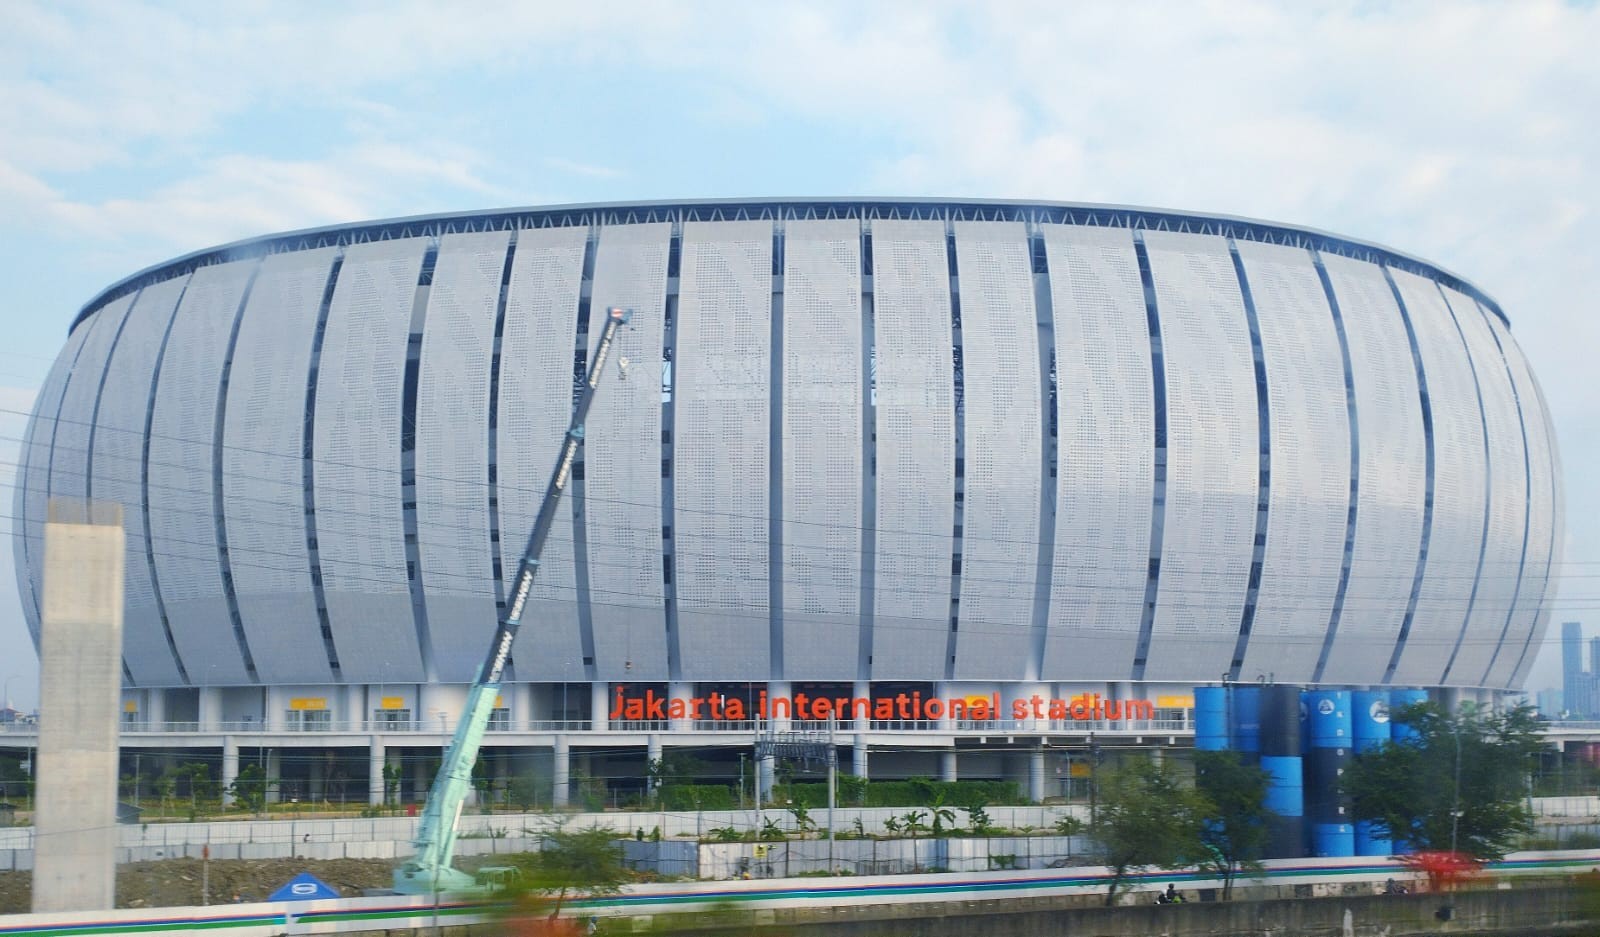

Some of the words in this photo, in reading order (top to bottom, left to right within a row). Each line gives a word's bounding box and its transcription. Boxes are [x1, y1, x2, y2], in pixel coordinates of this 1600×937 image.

[610, 685, 746, 720] jakarta
[759, 689, 1000, 721] international
[1011, 691, 1155, 721] stadium
